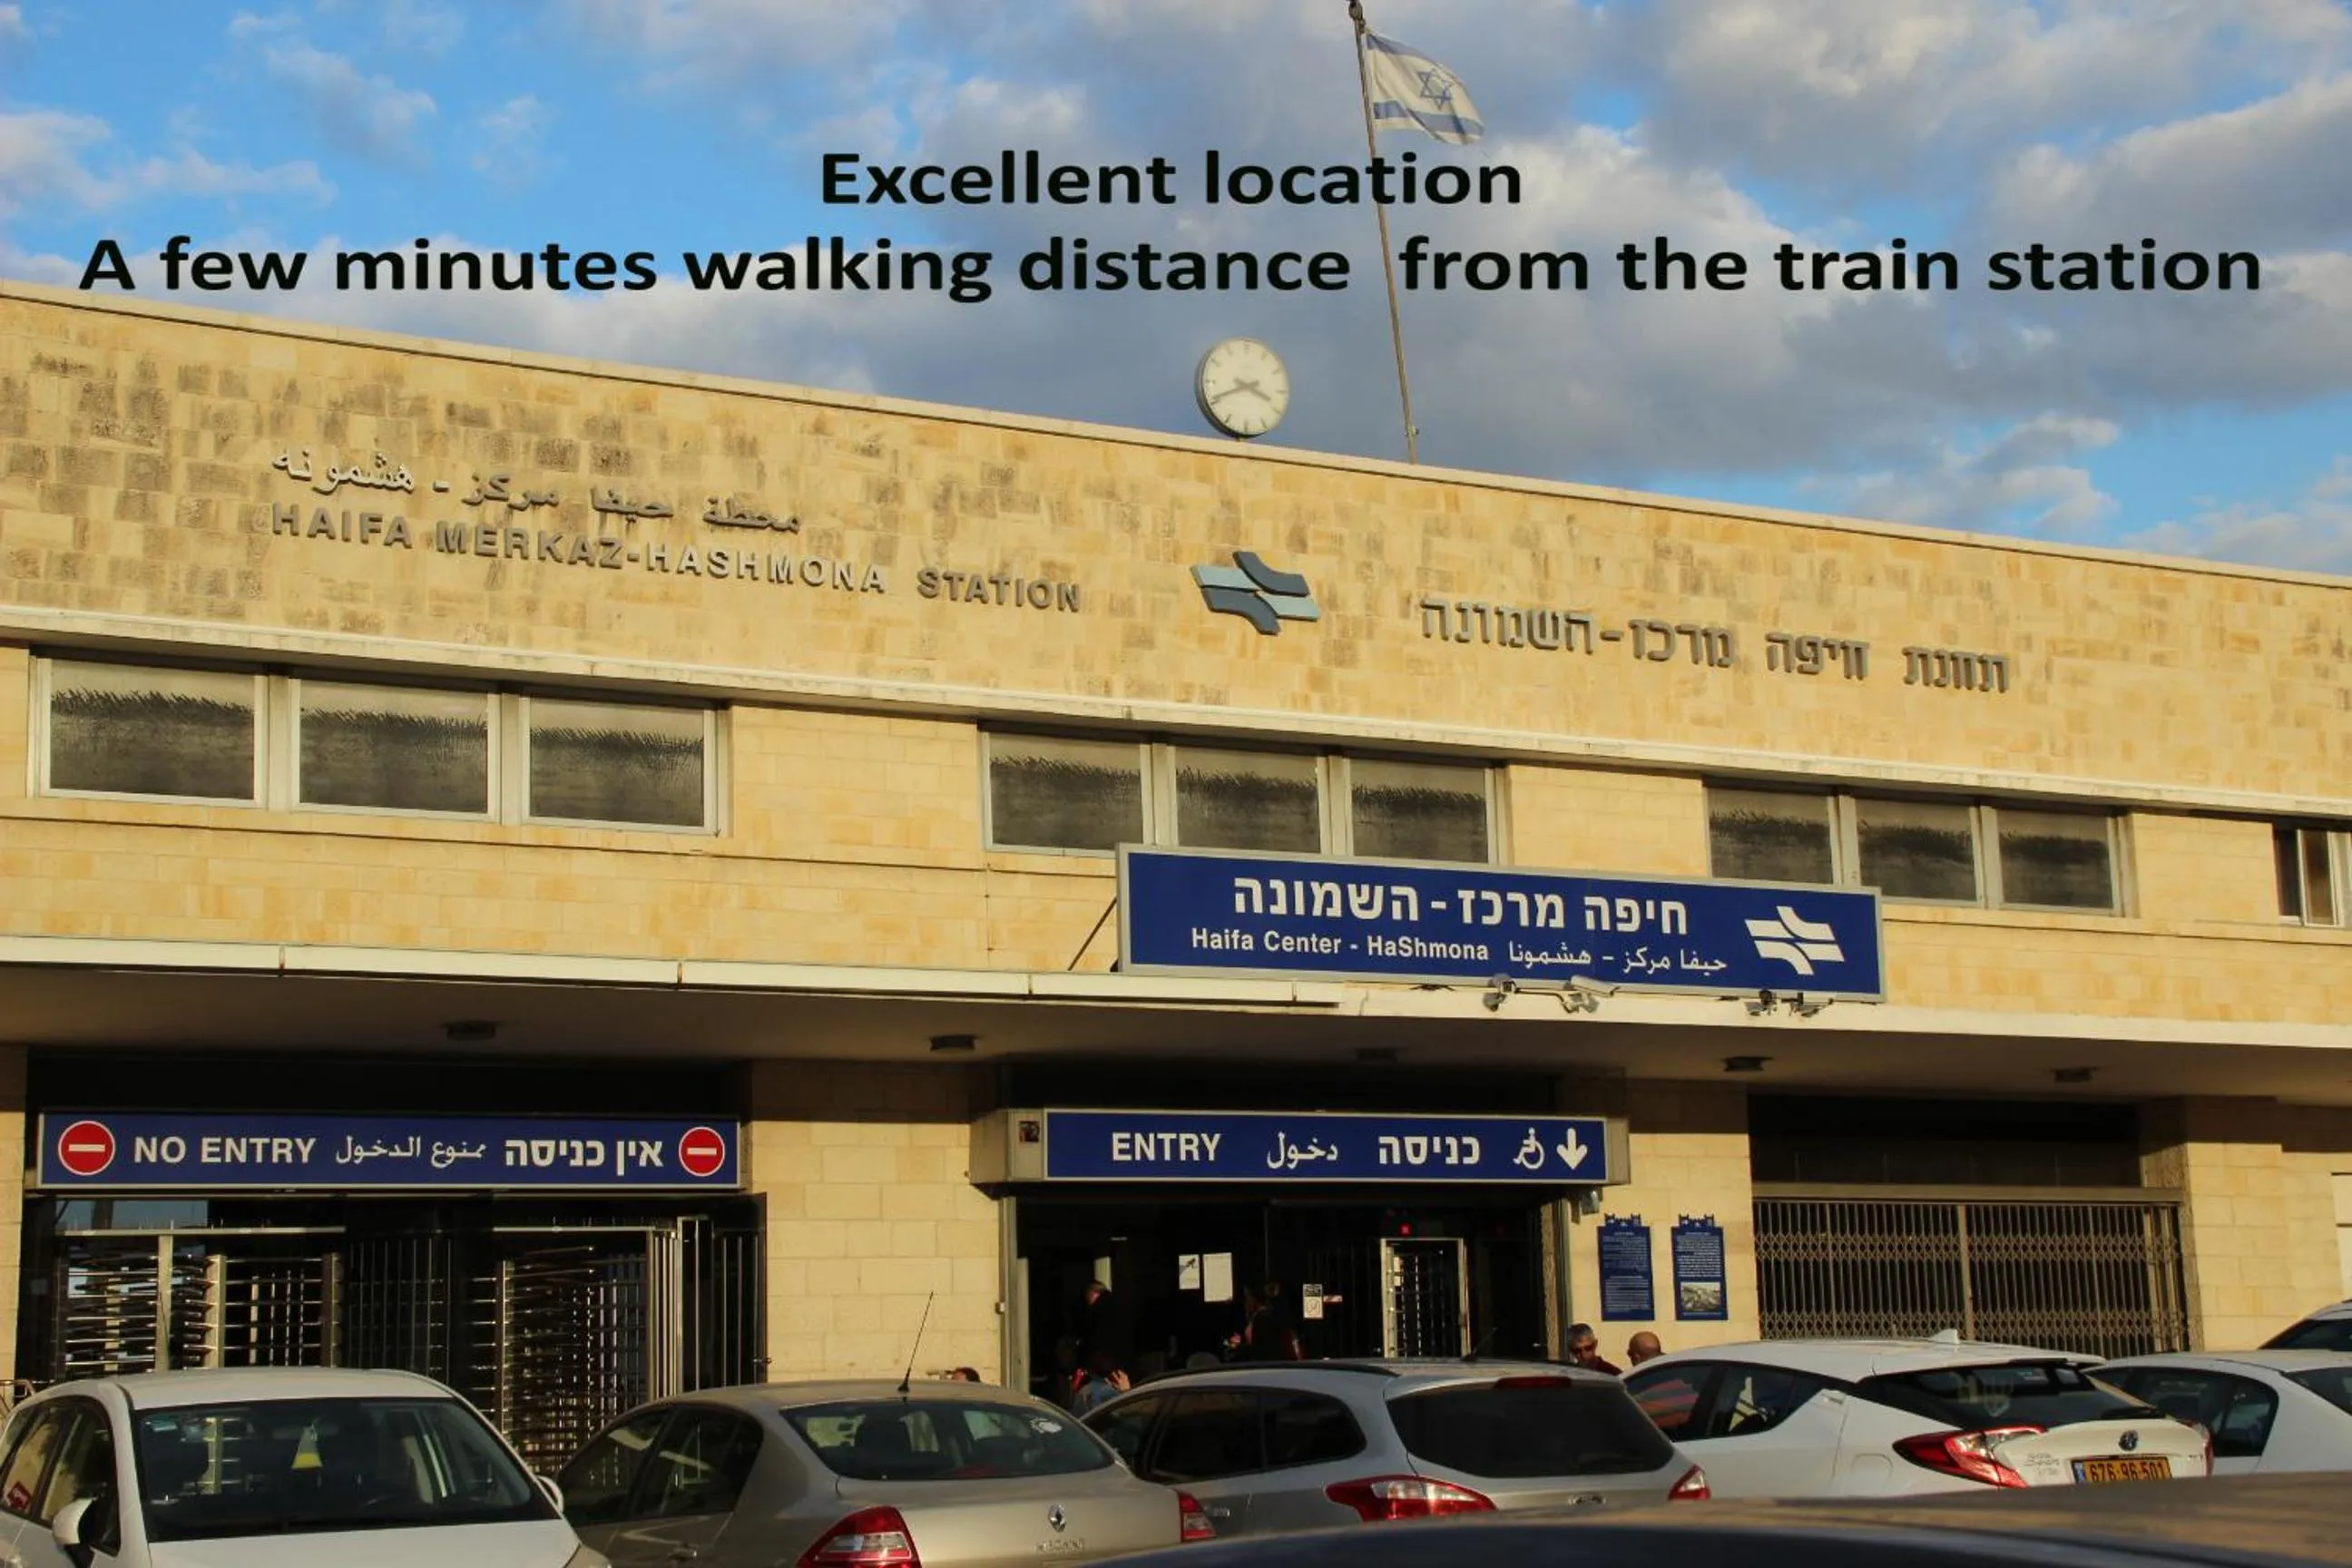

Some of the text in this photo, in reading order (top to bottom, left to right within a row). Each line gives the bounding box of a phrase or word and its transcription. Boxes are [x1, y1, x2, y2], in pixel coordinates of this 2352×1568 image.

[460, 472, 559, 511] مركز
[590, 485, 675, 524] حيفا
[702, 497, 802, 535] محطة
[272, 501, 1082, 613] HAIFA MERKAZ-HASHMONA STATION
[1763, 631, 1870, 681] חיפה
[1900, 644, 2011, 695] תחנת
[1233, 877, 1420, 922] השמונה
[1456, 888, 1566, 930] מרכז
[1583, 895, 1689, 936] חיפה
[1191, 926, 1255, 952] Haifa
[1263, 930, 1342, 955] Center
[1367, 935, 1489, 961] HaShmona
[1508, 940, 1592, 969] هشمونا
[1622, 946, 1671, 975] مركز
[1679, 948, 1728, 976] حيفا
[134, 1136, 317, 1163] NO ENTRY
[335, 1134, 421, 1165] الدخول
[505, 1139, 664, 1177] אין כניסה
[1112, 1132, 1221, 1162] ENTRY
[1266, 1131, 1339, 1170] دخول
[1378, 1135, 1481, 1165] כניסה
